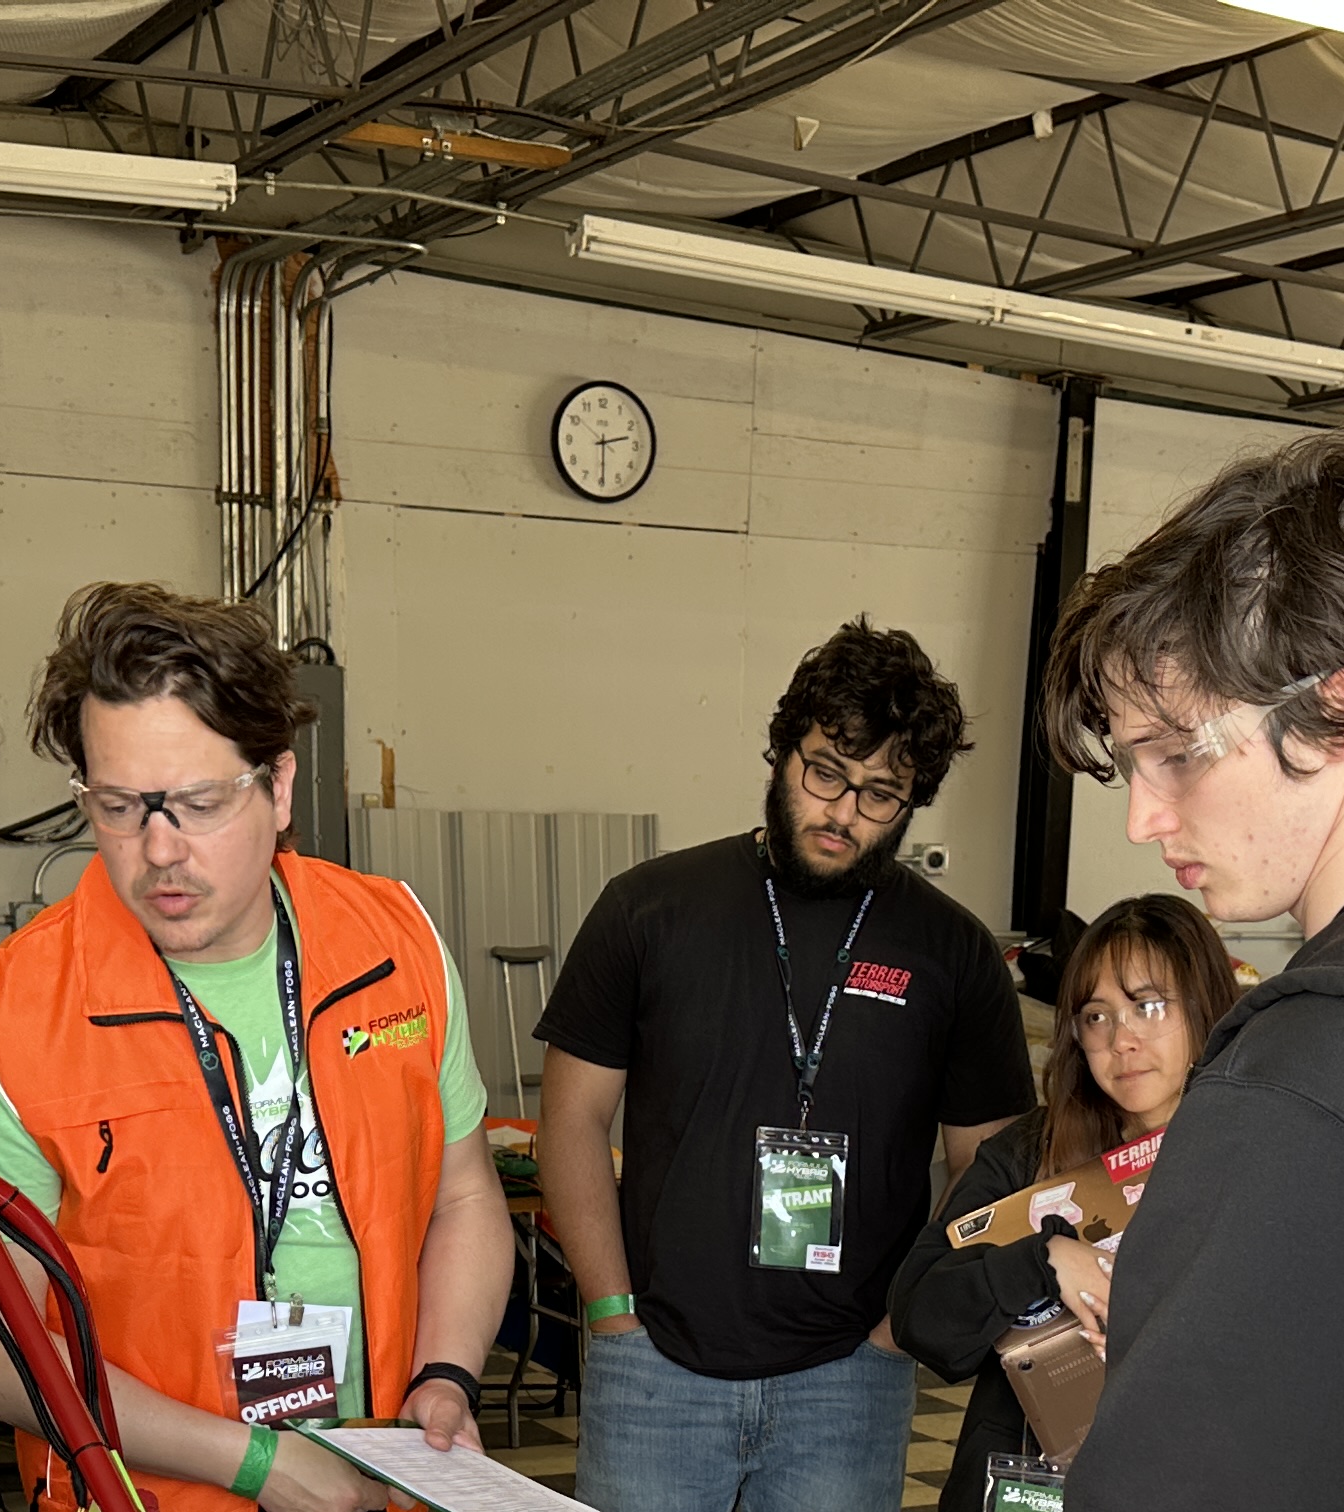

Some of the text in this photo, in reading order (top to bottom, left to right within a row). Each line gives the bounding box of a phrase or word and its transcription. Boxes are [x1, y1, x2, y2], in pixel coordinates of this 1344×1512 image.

[582, 401, 592, 413] 11
[597, 397, 609, 409] 12
[616, 404, 623, 416] 1
[569, 414, 581, 426] 10
[627, 420, 636, 432] 2
[565, 432, 573, 446] 9
[631, 440, 640, 452] 3
[569, 453, 578, 466] 8
[625, 459, 635, 471] 4
[581, 469, 590, 482] 7
[614, 472, 623, 485] 5
[850, 961, 912, 986] TERRIER
[285, 960, 301, 1064] MACLEAN-FOGG
[368, 1002, 427, 1034] FORMULA
[221, 1104, 261, 1207] MACLEAN-FOGG
[274, 1116, 298, 1219] MACLEAN-FOGG
[265, 1354, 325, 1369] FORMULA
[265, 1360, 326, 1377] HYBRID
[241, 1384, 334, 1424] OFFICIAL
